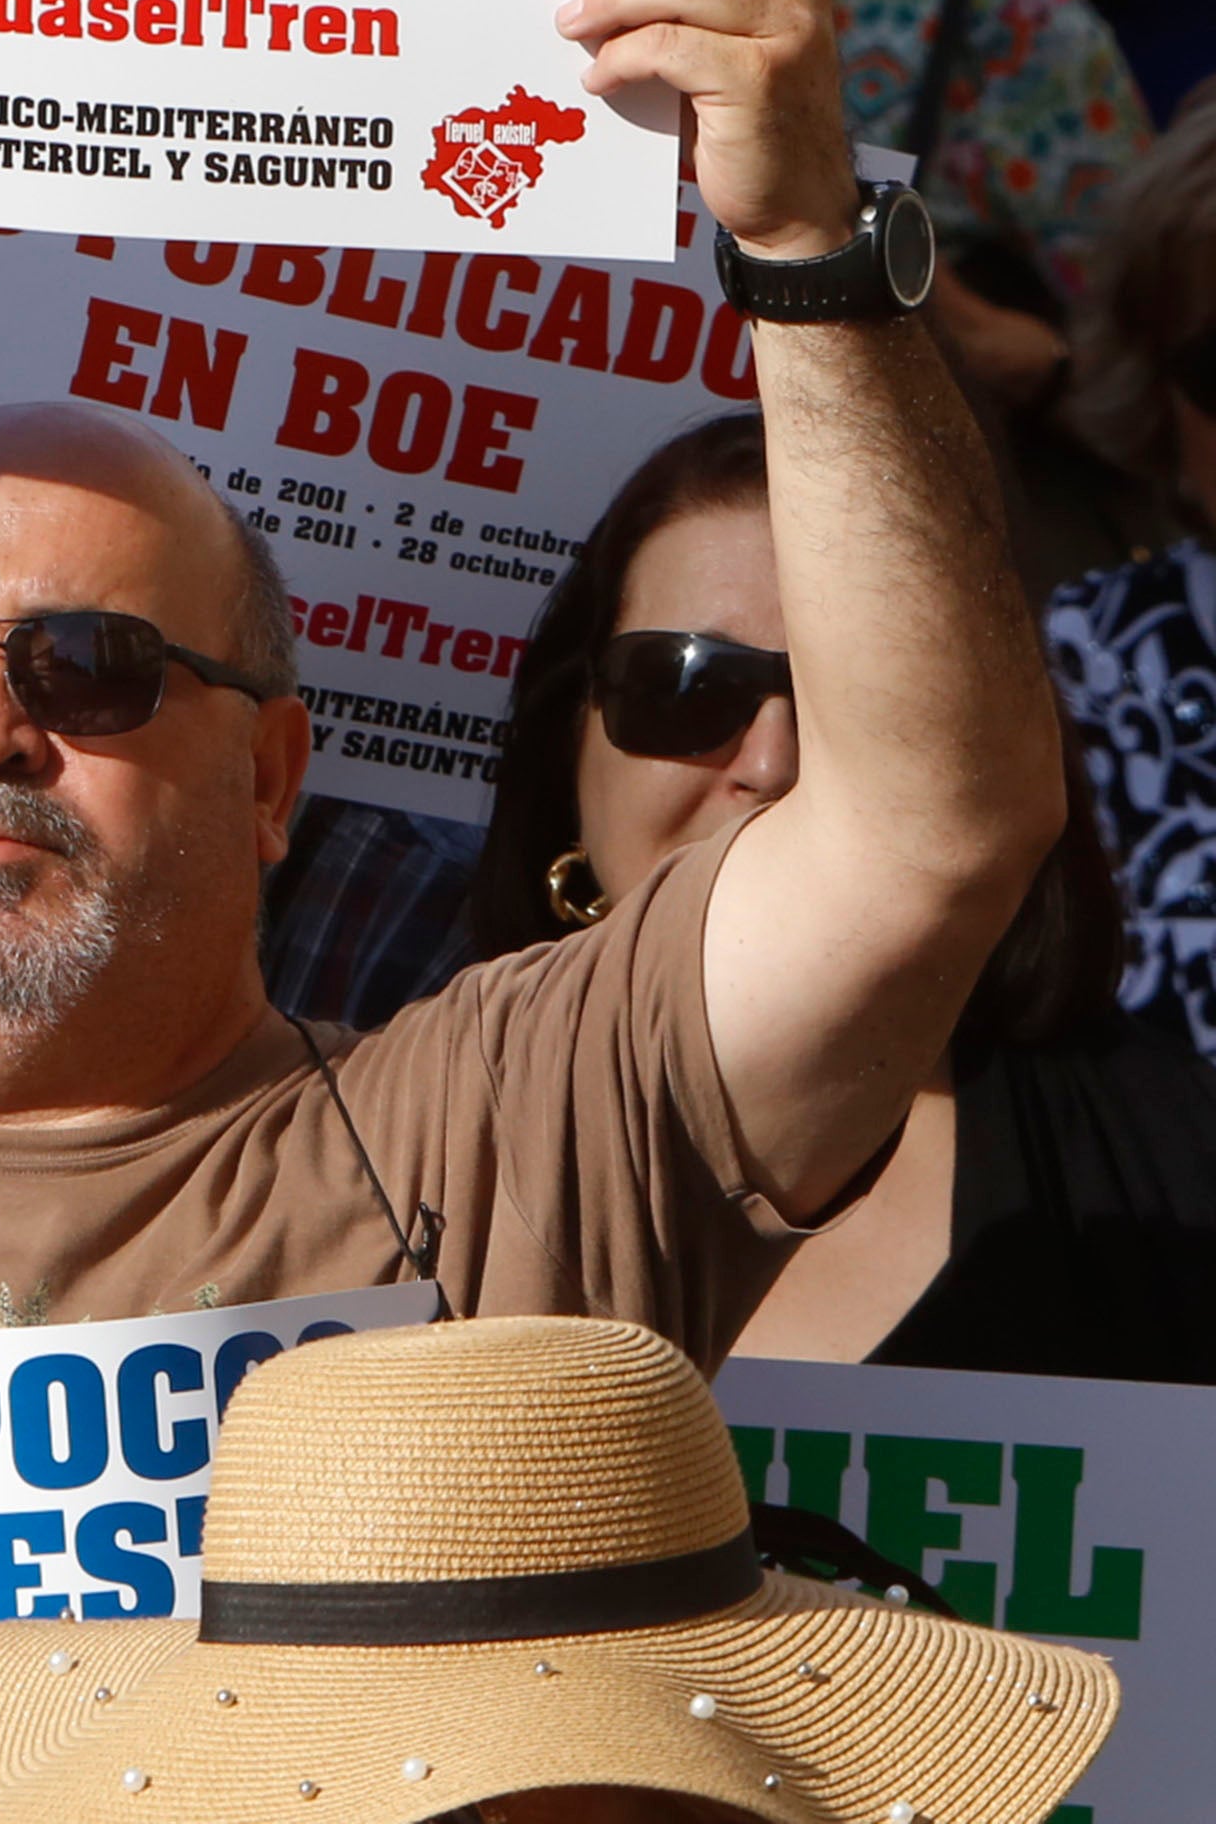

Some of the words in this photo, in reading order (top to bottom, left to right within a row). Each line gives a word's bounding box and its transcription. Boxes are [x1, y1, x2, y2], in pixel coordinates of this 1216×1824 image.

[444, 117, 485, 143] Teruel
[492, 120, 538, 146] existe!
[165, 150, 190, 180] Y
[204, 152, 393, 190] SAGUNTO
[68, 296, 248, 432] EN
[275, 348, 539, 494] BOE
[227, 467, 262, 496] de
[277, 477, 347, 513] 2001
[394, 501, 416, 527] 2
[430, 509, 465, 537] de
[247, 506, 282, 534] de
[293, 515, 357, 550] 2011
[398, 536, 438, 565] 28
[448, 550, 557, 587] octubre
